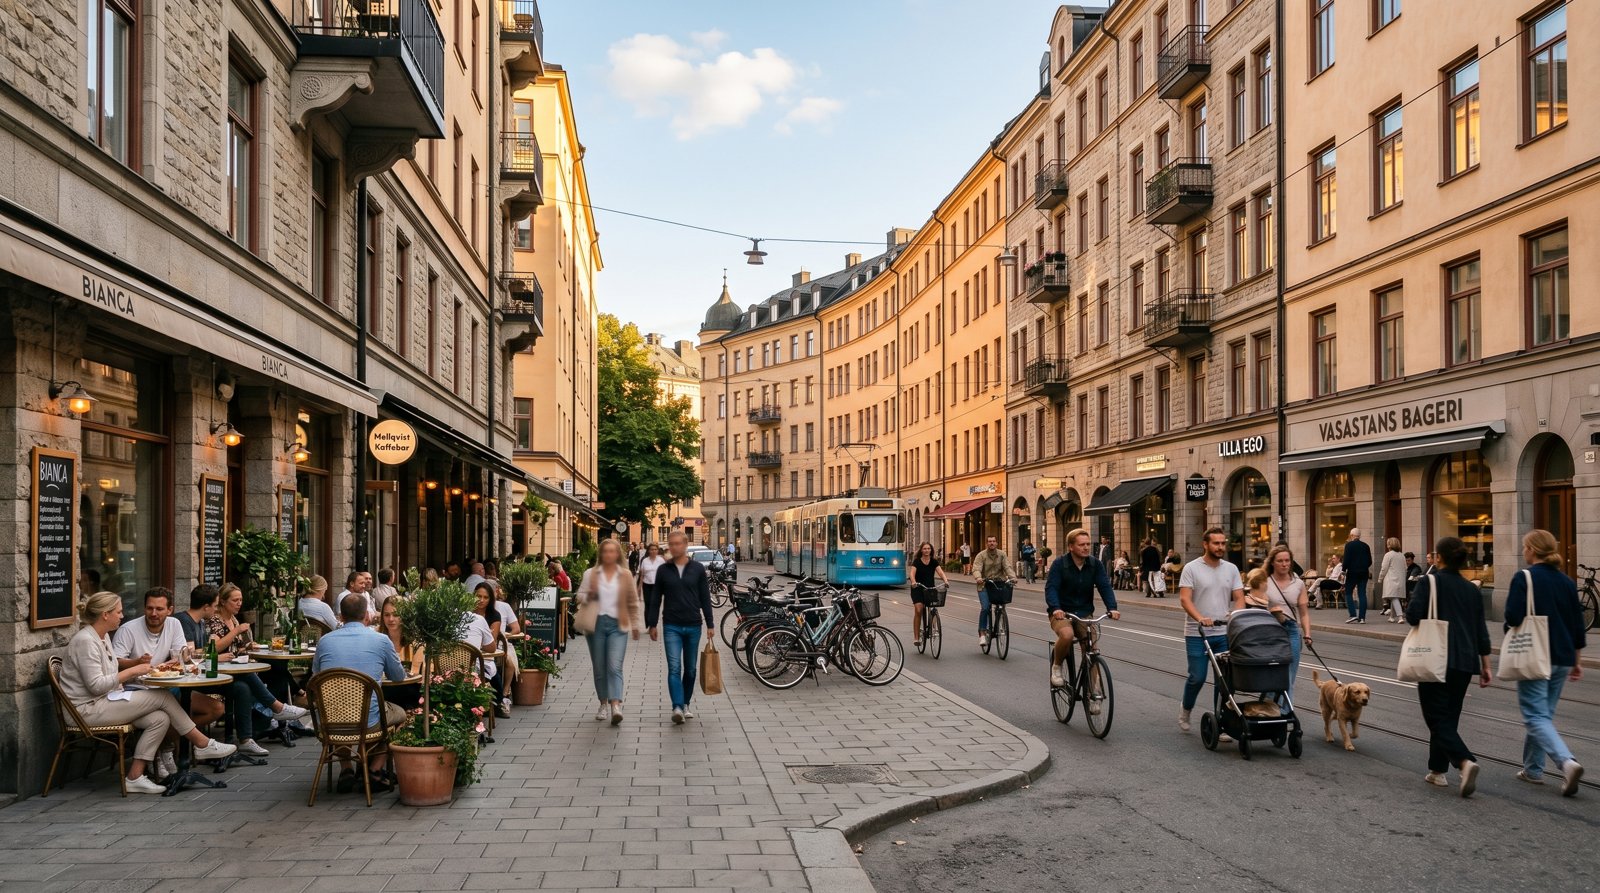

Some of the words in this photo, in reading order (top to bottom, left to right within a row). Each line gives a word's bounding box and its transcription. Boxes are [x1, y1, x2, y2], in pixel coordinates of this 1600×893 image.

[83, 275, 135, 317] BIANCA
[262, 355, 289, 380] BIANCA
[1319, 410, 1397, 442] VASASTANS
[1402, 398, 1463, 430] BAGERI
[374, 433, 411, 443] Mellqvist
[375, 443, 410, 452] Kaffebar
[1218, 440, 1241, 457] LILLA
[1243, 435, 1263, 454] EGO
[40, 461, 68, 484] BIANCA
